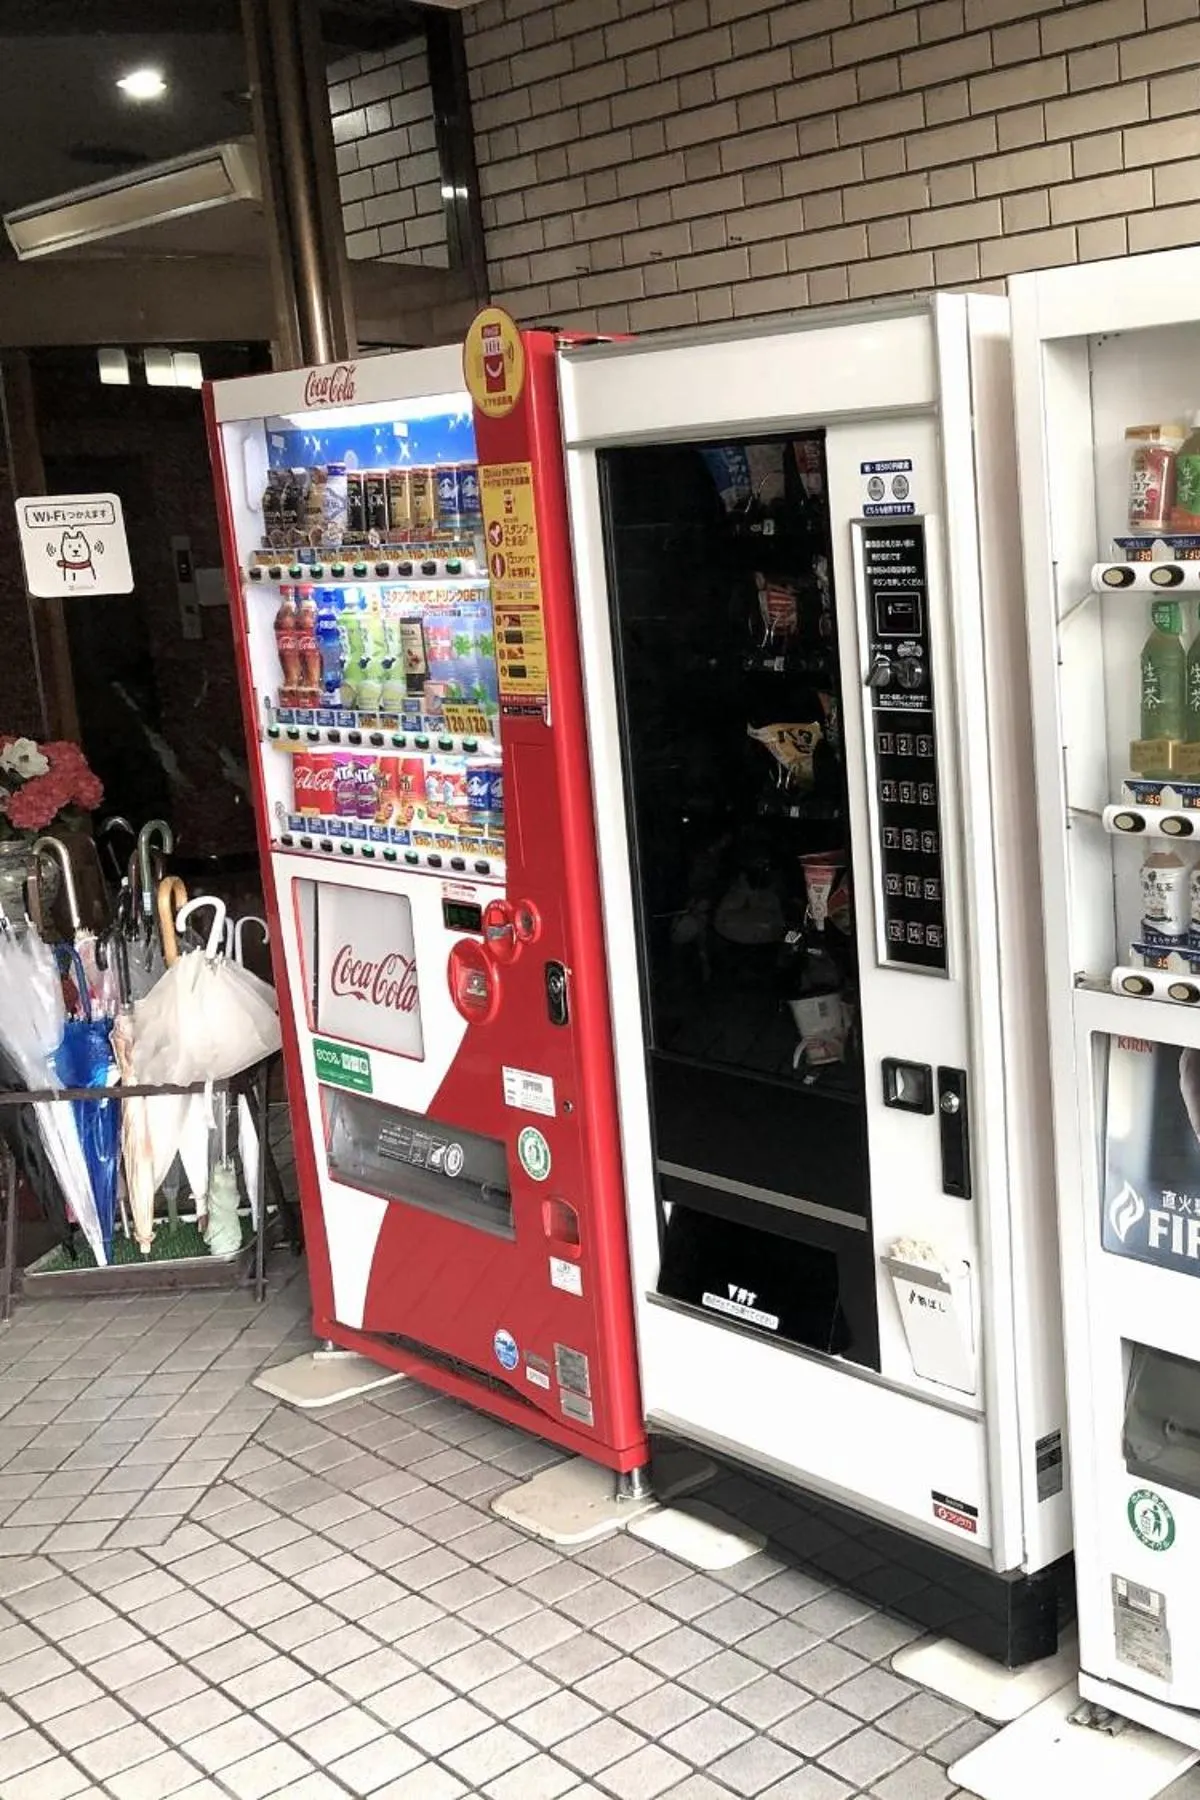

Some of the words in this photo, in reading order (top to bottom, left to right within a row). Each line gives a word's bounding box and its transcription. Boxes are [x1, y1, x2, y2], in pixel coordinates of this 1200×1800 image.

[304, 364, 357, 407] Coca-Cola
[1143, 661, 1164, 709] 生茶
[331, 944, 418, 1013] Coca-Cola
[1117, 1036, 1152, 1052] KIRIN
